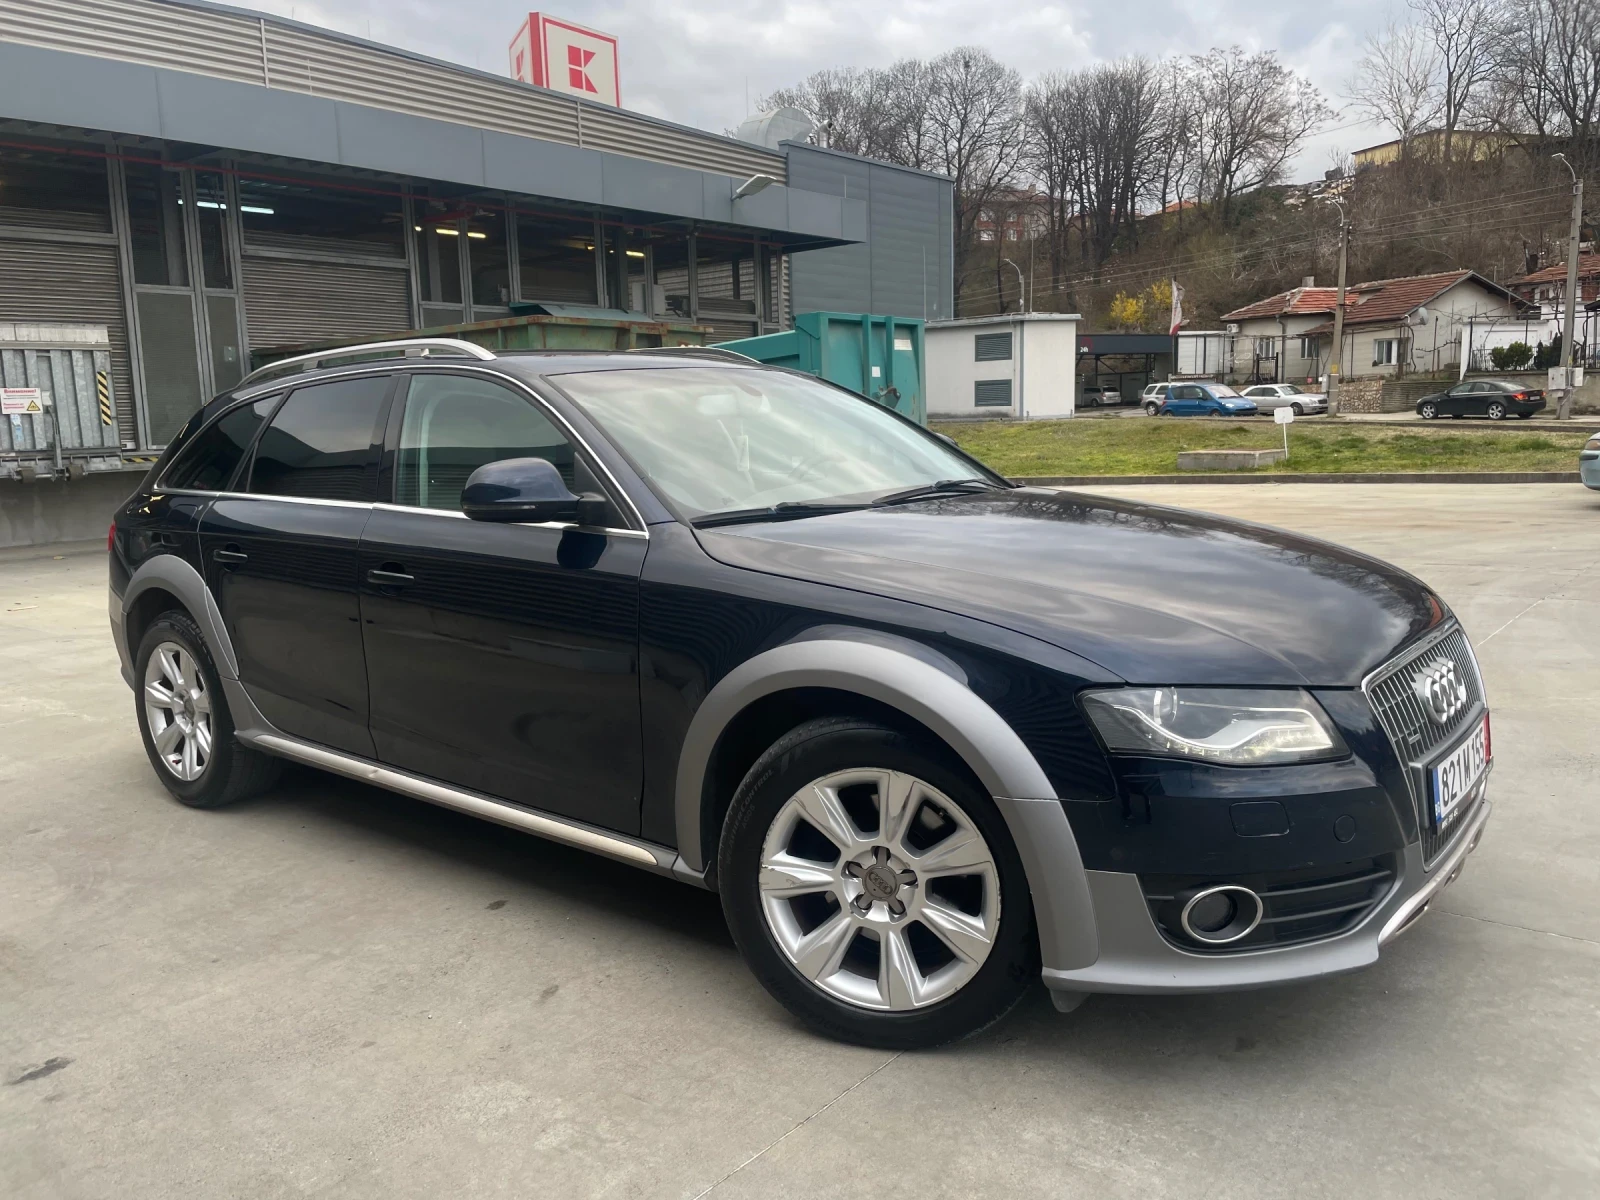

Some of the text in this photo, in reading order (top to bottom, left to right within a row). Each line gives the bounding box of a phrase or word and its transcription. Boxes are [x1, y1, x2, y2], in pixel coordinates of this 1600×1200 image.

[567, 45, 598, 94] K
[1441, 753, 1463, 808] 821
[1463, 744, 1471, 787] M
[1471, 726, 1484, 776] 155
